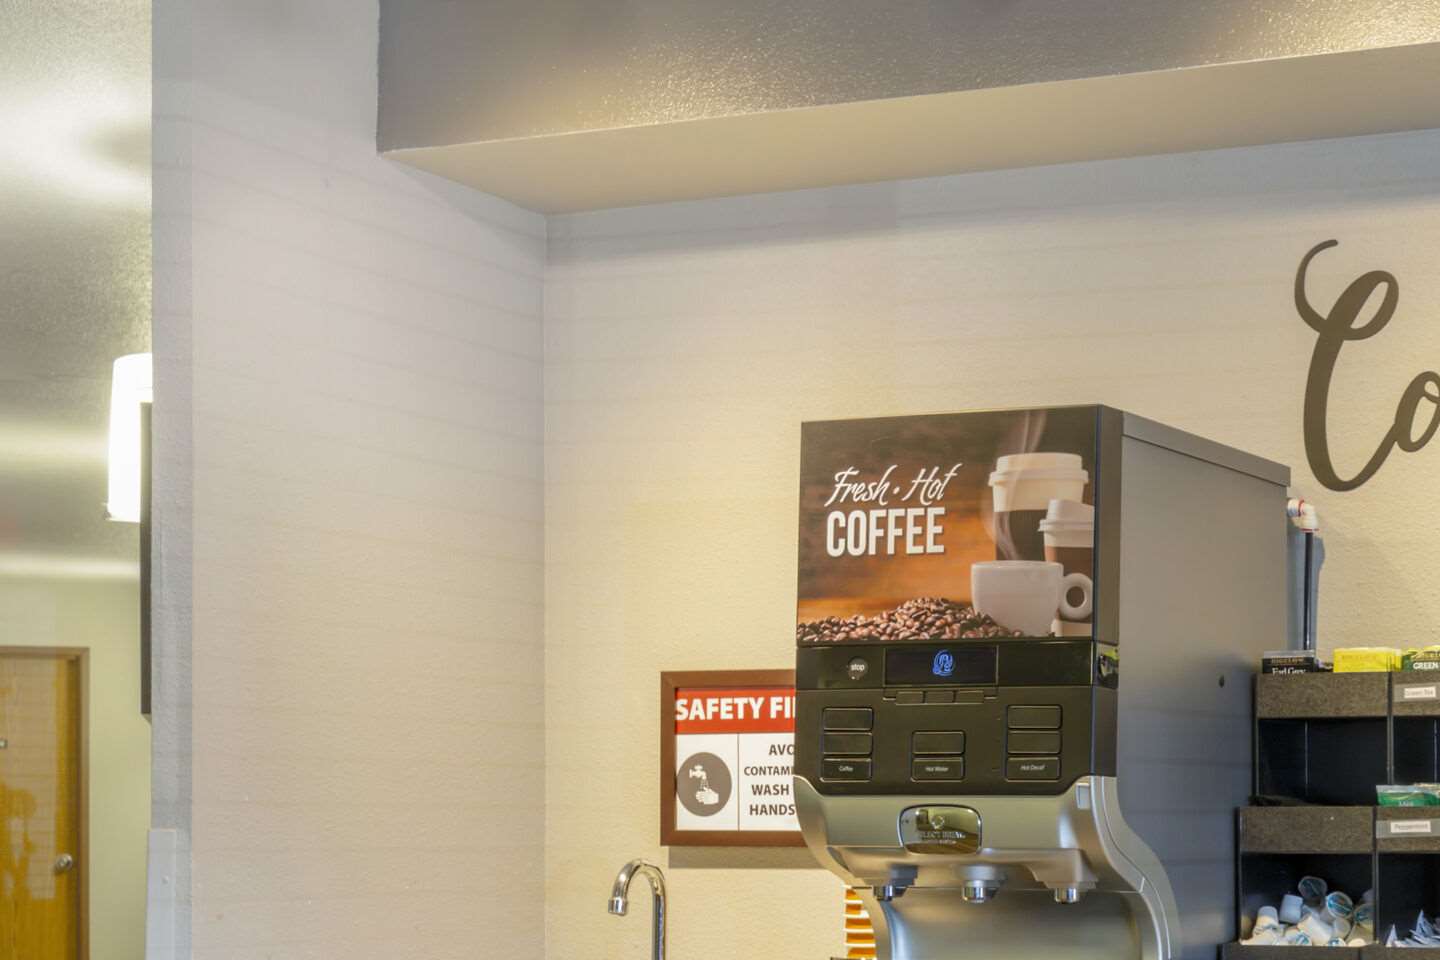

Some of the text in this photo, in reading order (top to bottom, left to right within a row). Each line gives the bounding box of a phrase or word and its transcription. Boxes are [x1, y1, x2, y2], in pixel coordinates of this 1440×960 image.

[824, 463, 963, 507] Fresh Hot
[826, 507, 945, 557] COFFEE
[850, 663, 865, 672] stop
[1412, 661, 1439, 670] GREEN
[675, 696, 795, 720] SAFETY FI
[751, 784, 789, 796] WASH
[749, 804, 795, 816] HANDS
